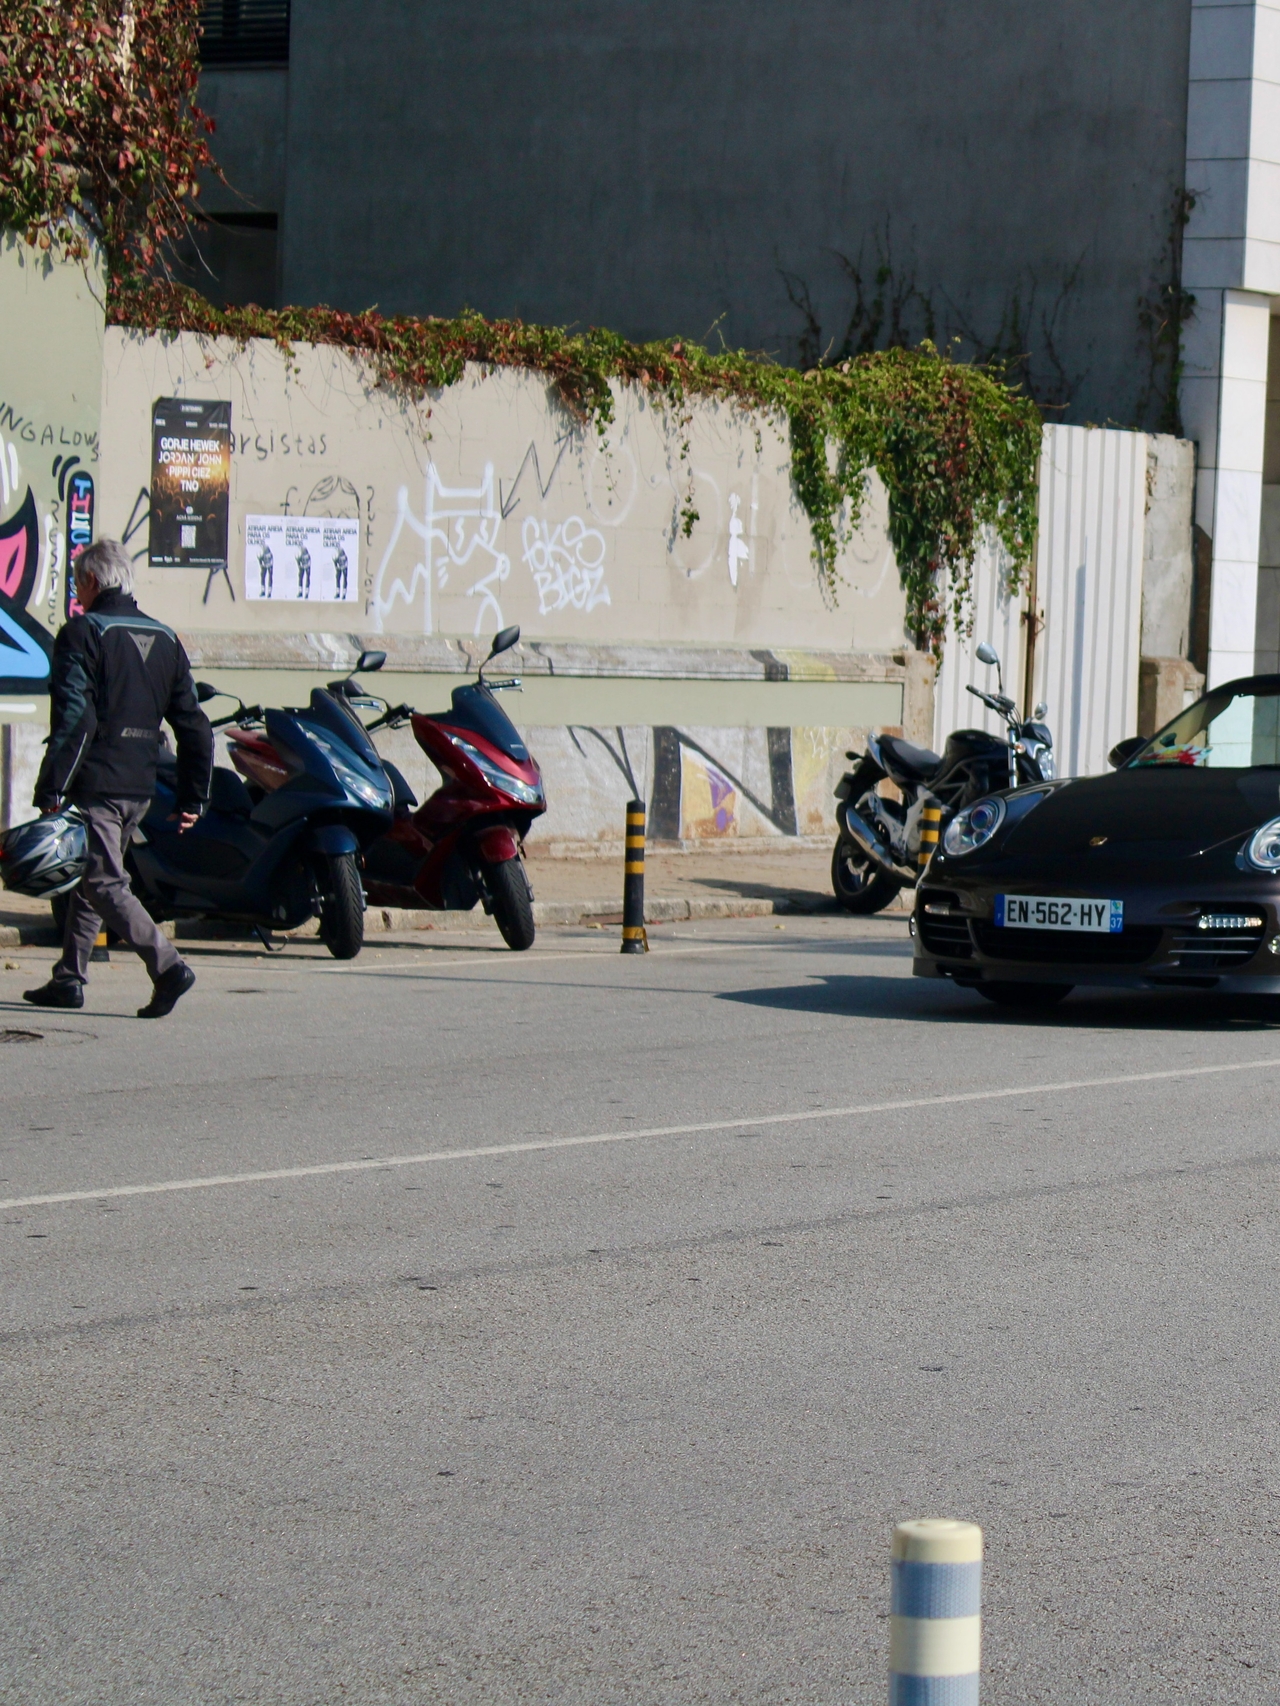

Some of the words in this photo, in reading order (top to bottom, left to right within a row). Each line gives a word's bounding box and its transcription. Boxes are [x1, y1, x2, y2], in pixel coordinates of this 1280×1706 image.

[160, 437, 189, 451] GORJE
[190, 438, 220, 452] HEWEK
[197, 453, 222, 465] JOHN
[191, 467, 211, 479] CIEZ
[180, 480, 199, 493] TNO
[1110, 917, 1122, 928] 37
